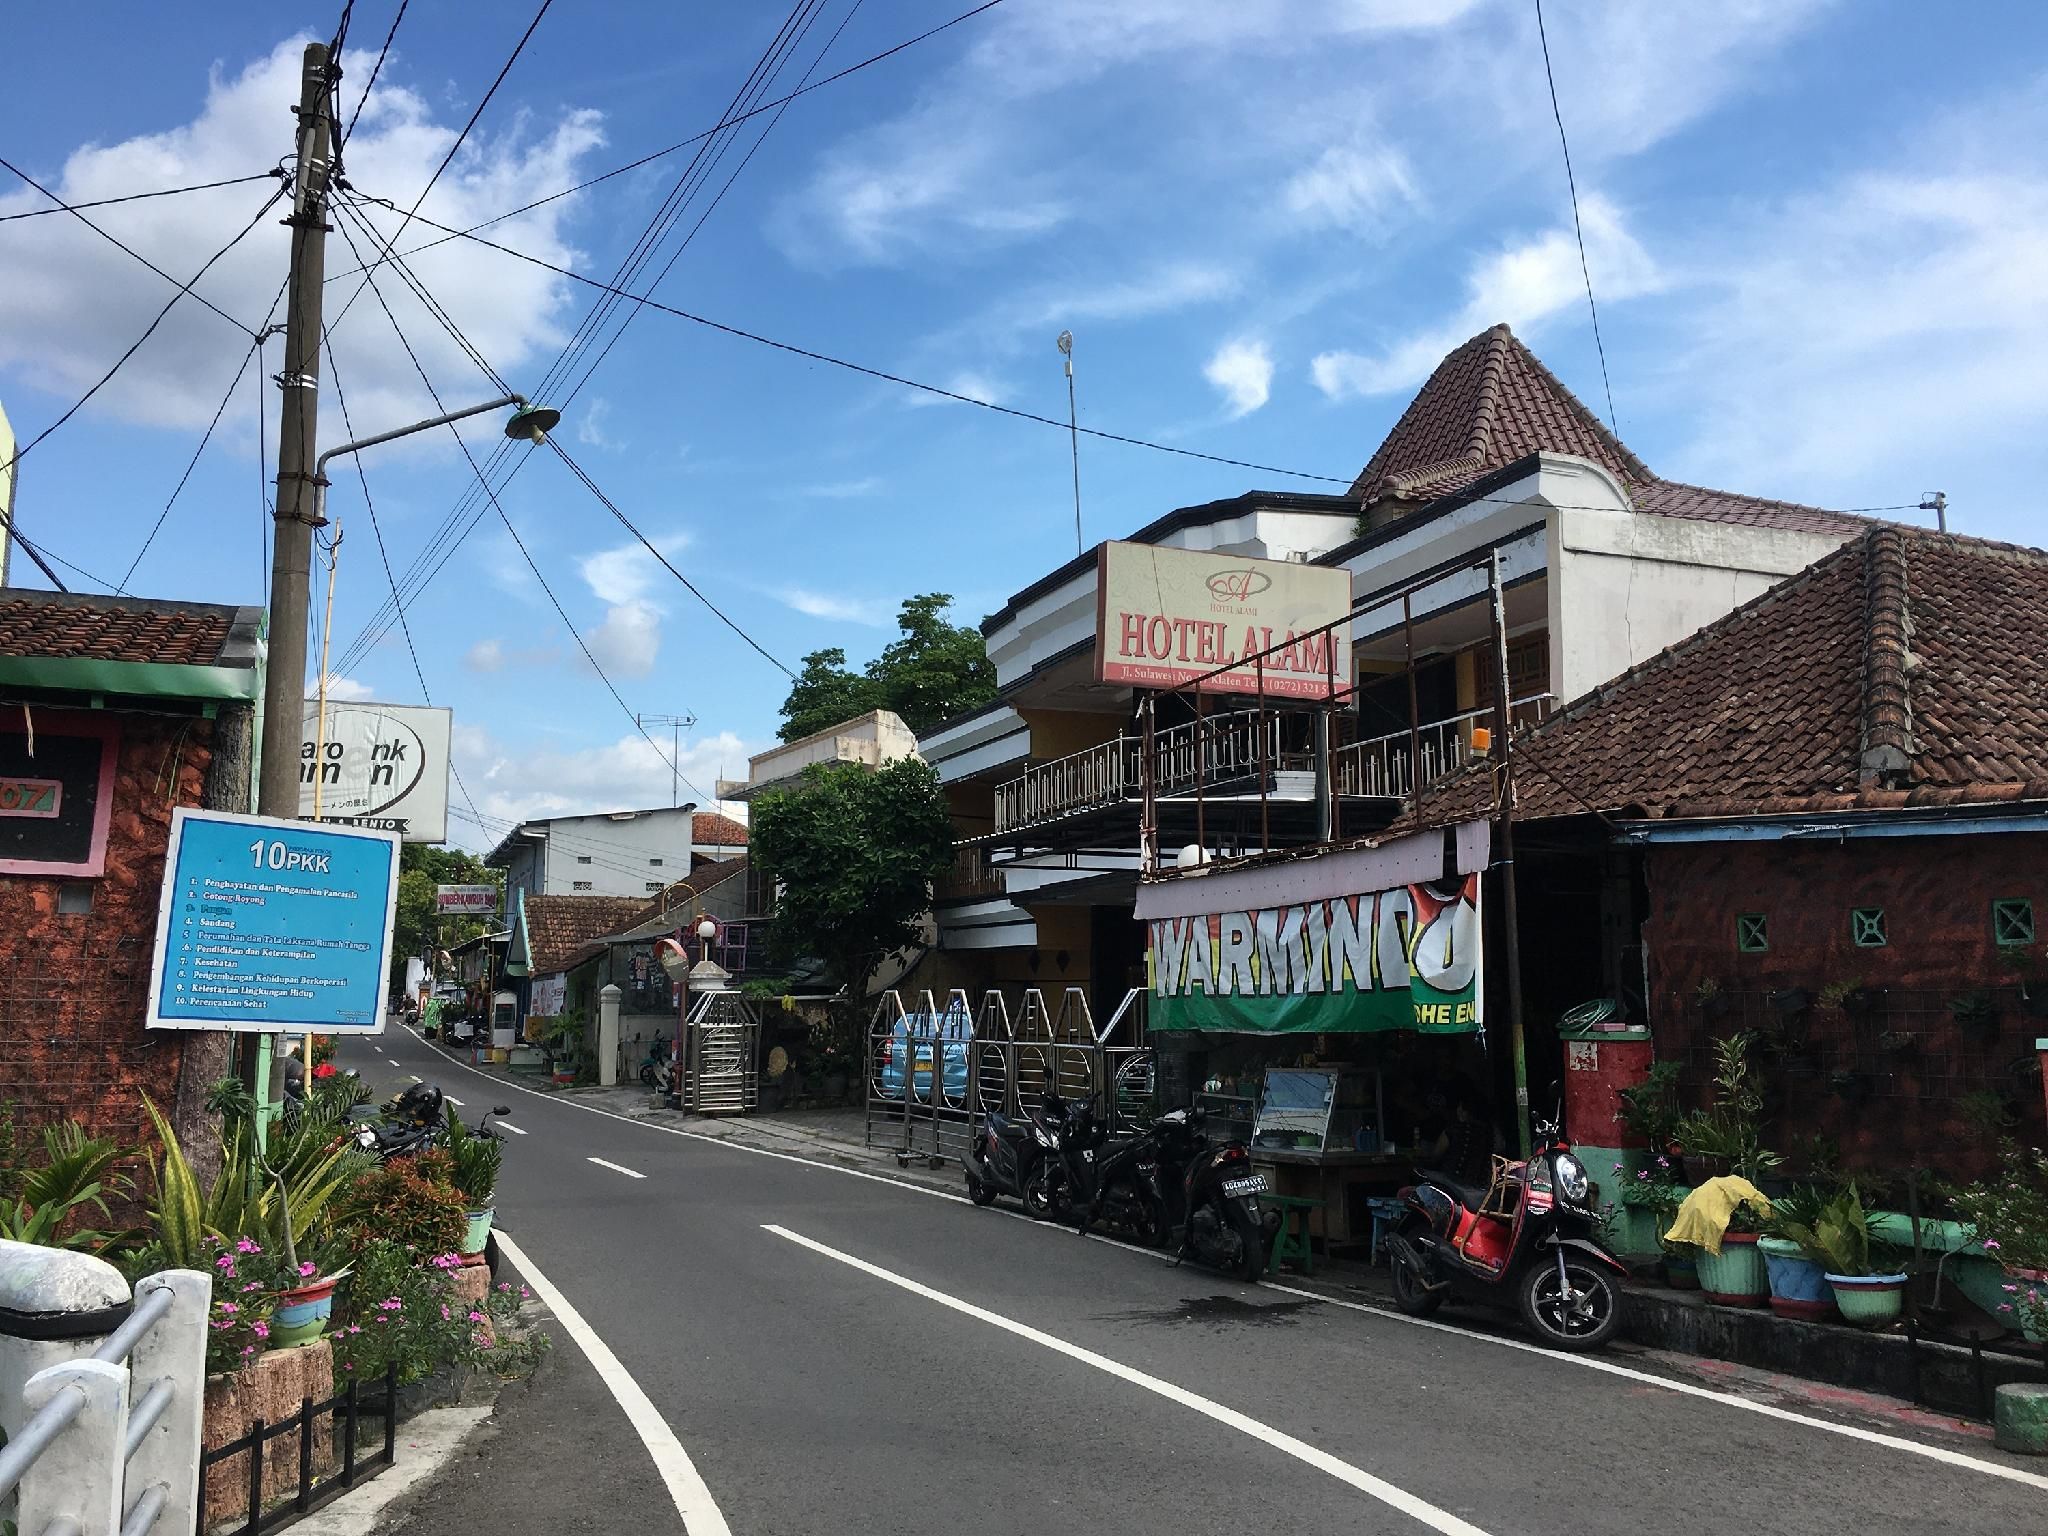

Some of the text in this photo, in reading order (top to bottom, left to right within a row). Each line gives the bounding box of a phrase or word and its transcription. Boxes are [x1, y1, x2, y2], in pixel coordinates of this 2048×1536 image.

[1210, 602, 1258, 617] HOTEL ALAMI
[1119, 612, 1340, 676] HOTEL ALAMI
[1134, 667, 1175, 682] Sulawesi
[1211, 673, 1241, 686] Klaten
[1269, 680, 1301, 694] (0272)
[1303, 683, 1319, 694] 321
[353, 818, 396, 830] BENTO
[250, 838, 331, 874] 10 PKK
[205, 878, 257, 891] Penghayatan
[259, 884, 275, 892] dan
[275, 884, 323, 896] Pengamalan
[324, 888, 358, 899] Pancasila
[203, 892, 234, 903] Gotong
[235, 894, 265, 906] Royong
[200, 918, 236, 930] Sandang
[198, 931, 246, 943] Perumahan
[246, 935, 262, 943] dan
[264, 936, 282, 945] Tata
[316, 939, 343, 949] Rumah
[345, 940, 371, 952] Tangga
[197, 944, 244, 955] Pendidikan
[245, 948, 260, 956] dan
[262, 948, 316, 960] Keterampilan
[195, 957, 238, 968] Kesehatan
[193, 970, 254, 983] Pengembangan
[256, 974, 299, 985] Kehidupan
[300, 976, 346, 988] Berkoperasi
[191, 984, 239, 994] Kelestarian
[241, 987, 288, 998] Lingkungan
[290, 989, 314, 999] Hidup
[190, 997, 243, 1008] Perencanaan
[244, 999, 267, 1008] Sehat
